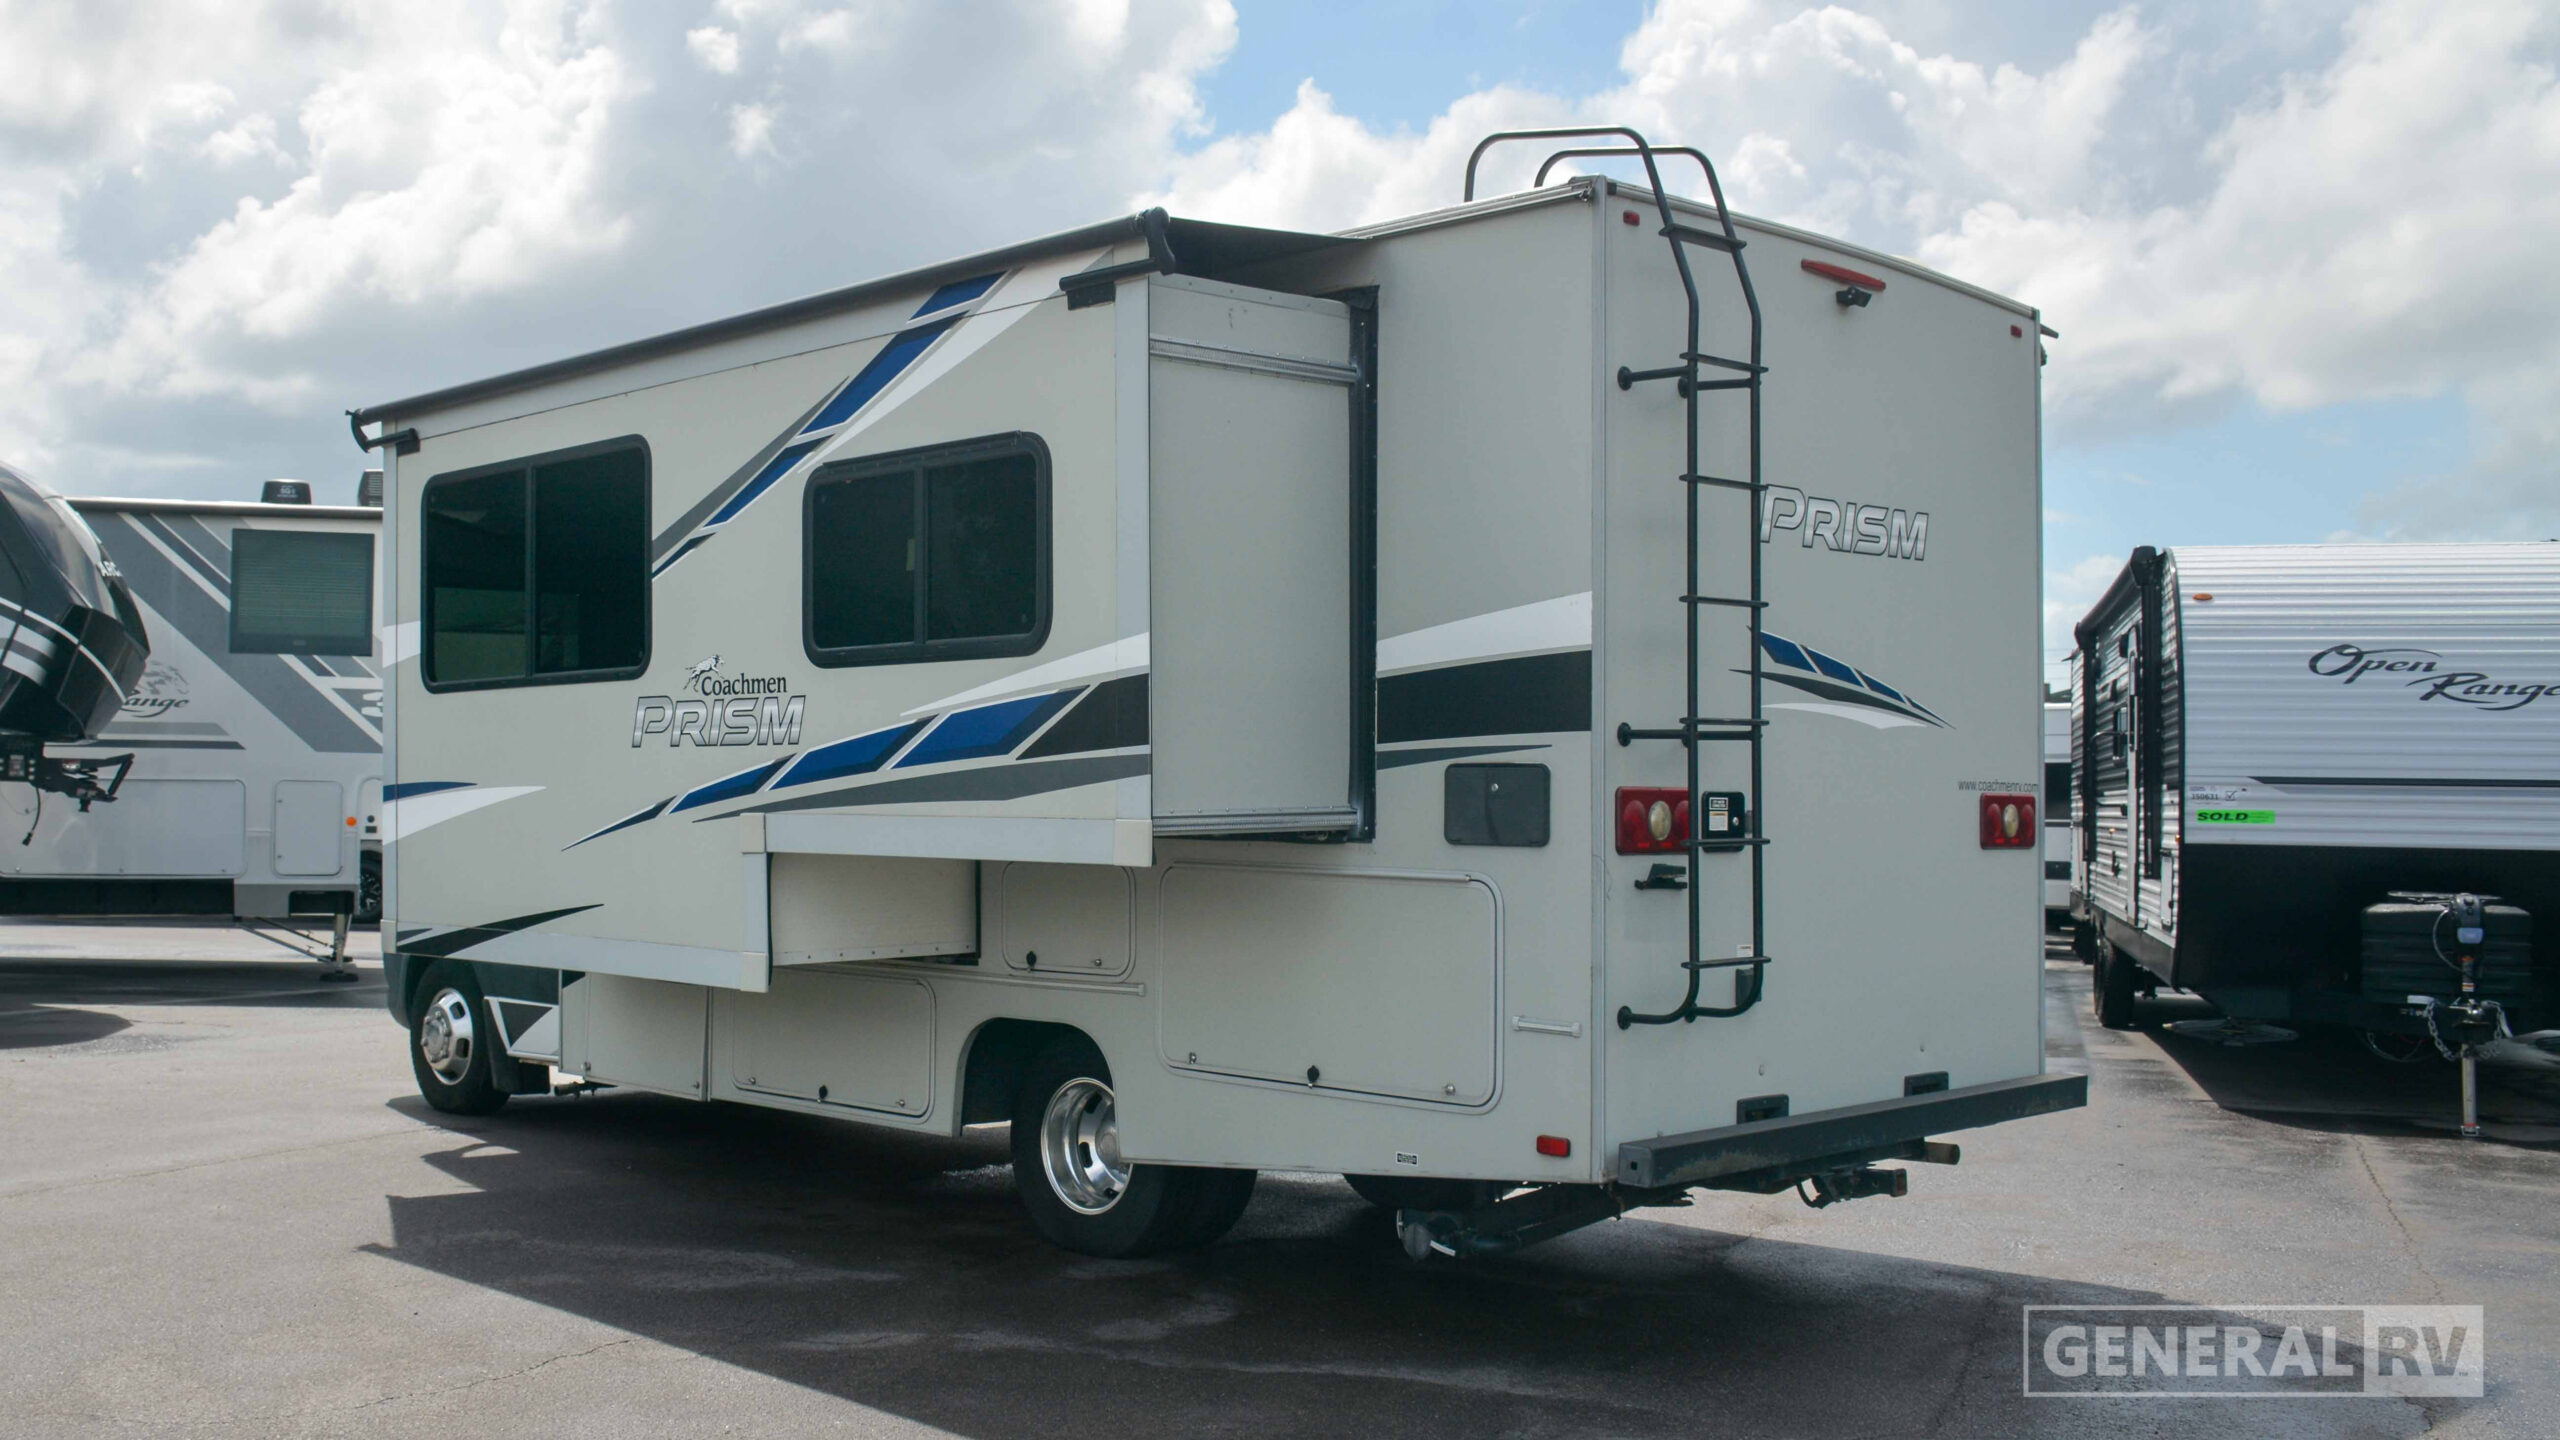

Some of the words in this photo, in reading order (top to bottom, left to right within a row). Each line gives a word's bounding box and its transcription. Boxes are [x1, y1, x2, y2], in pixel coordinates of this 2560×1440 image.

[1760, 484, 1929, 561] PRISM
[2309, 644, 2442, 684] Open
[701, 673, 787, 696] Coachmen
[120, 689, 190, 718] ange
[631, 695, 806, 748] PRISM
[2197, 812, 2249, 821] SOLD
